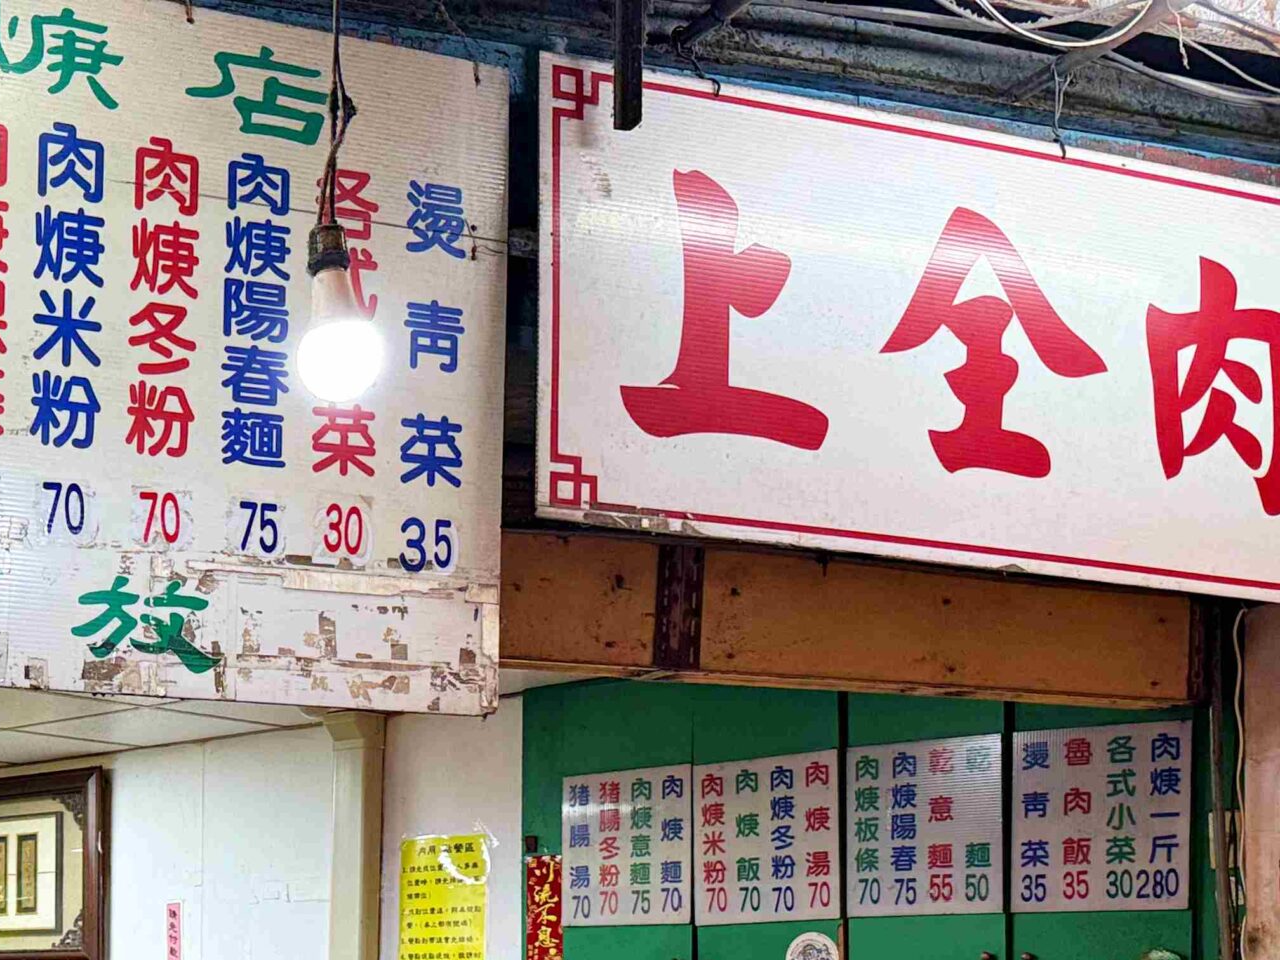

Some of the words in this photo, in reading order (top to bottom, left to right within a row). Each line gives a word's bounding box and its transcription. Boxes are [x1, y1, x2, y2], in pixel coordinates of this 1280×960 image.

[28, 122, 105, 449] 肉焿米粉
[125, 136, 200, 458] 肉焿冬粉
[221, 153, 292, 469] 肉焿陽春麵
[399, 180, 466, 489] 燙青菜
[620, 169, 1280, 517] 上全肉
[42, 482, 85, 536] 70
[139, 492, 180, 545] 70
[240, 500, 279, 554] 75
[324, 503, 364, 556] 30
[399, 517, 452, 572] 35
[808, 881, 831, 908] 70
[858, 879, 881, 905] 70
[894, 878, 917, 905] 75
[929, 874, 953, 902] 55
[965, 874, 990, 901] 50
[1021, 874, 1047, 902] 35
[1063, 871, 1090, 900] 35
[1106, 871, 1133, 899] 30
[1136, 869, 1179, 899] 280
[572, 896, 591, 920] 70
[600, 891, 618, 915] 70
[632, 890, 651, 915] 75
[661, 888, 682, 912] 70
[706, 888, 727, 913] 70
[739, 887, 761, 913] 70
[773, 887, 794, 913] 70
